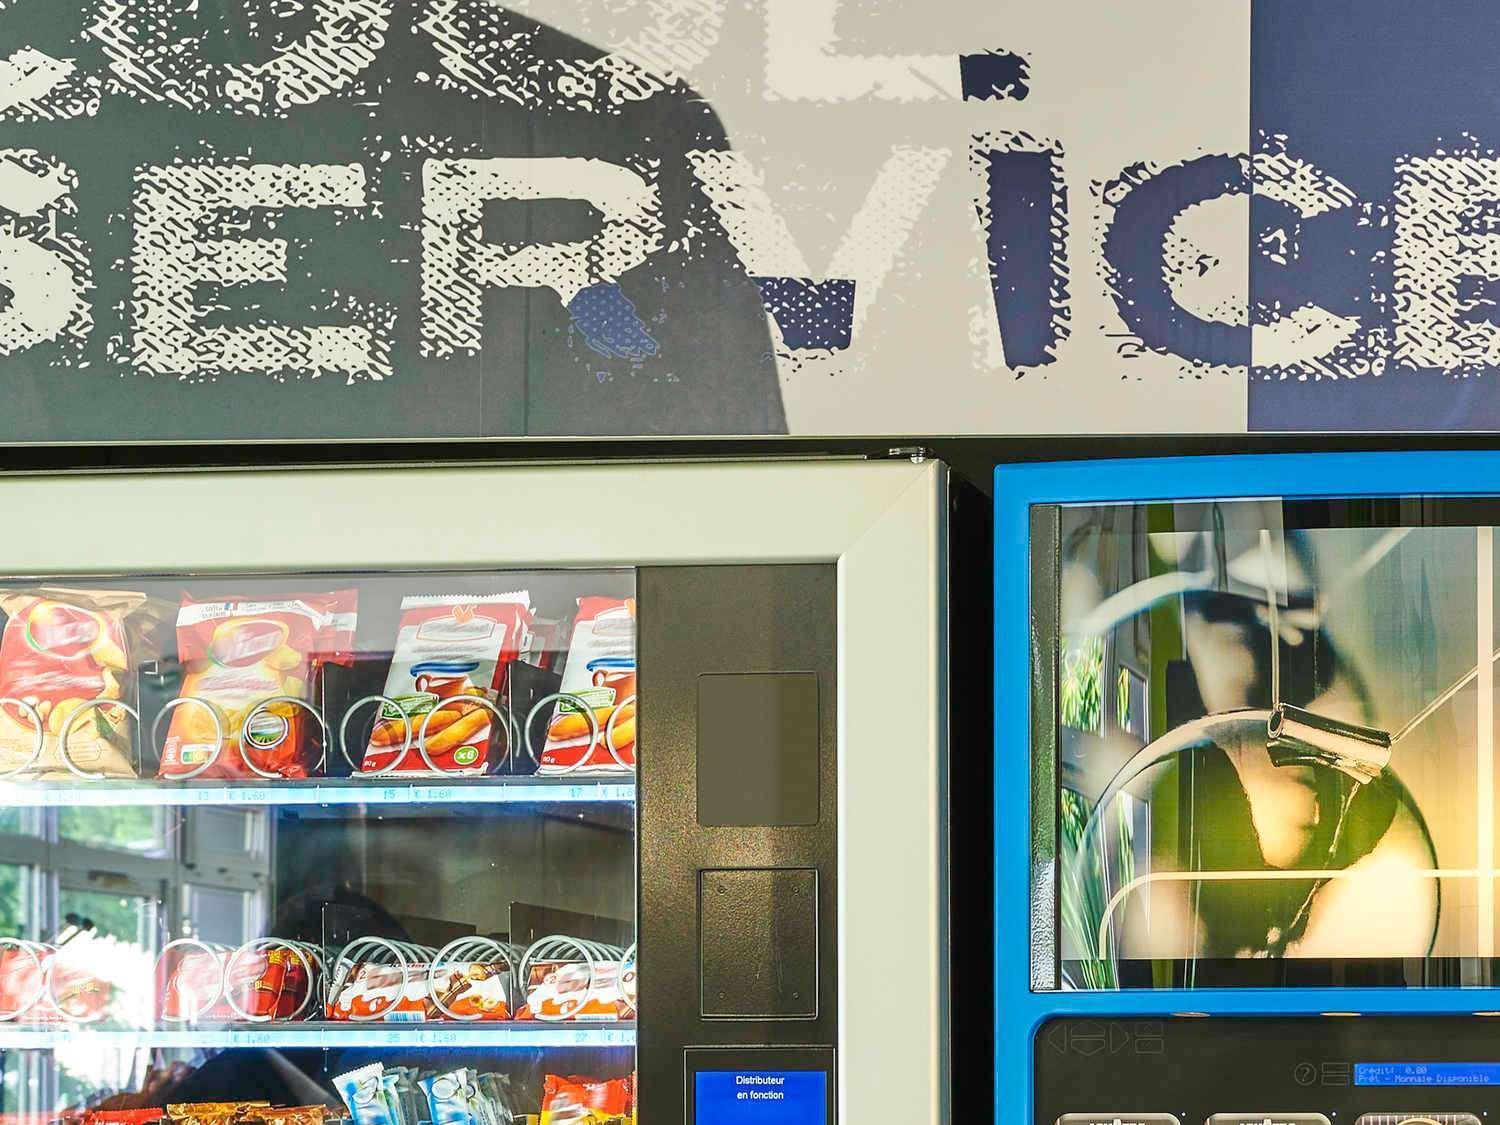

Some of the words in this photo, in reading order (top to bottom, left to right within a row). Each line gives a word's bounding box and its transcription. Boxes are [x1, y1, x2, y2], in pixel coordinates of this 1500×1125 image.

[459, 750, 475, 760] x6
[736, 1075, 785, 1085] Distributeur
[737, 1092, 748, 1100] en
[750, 1090, 784, 1100] fonction
